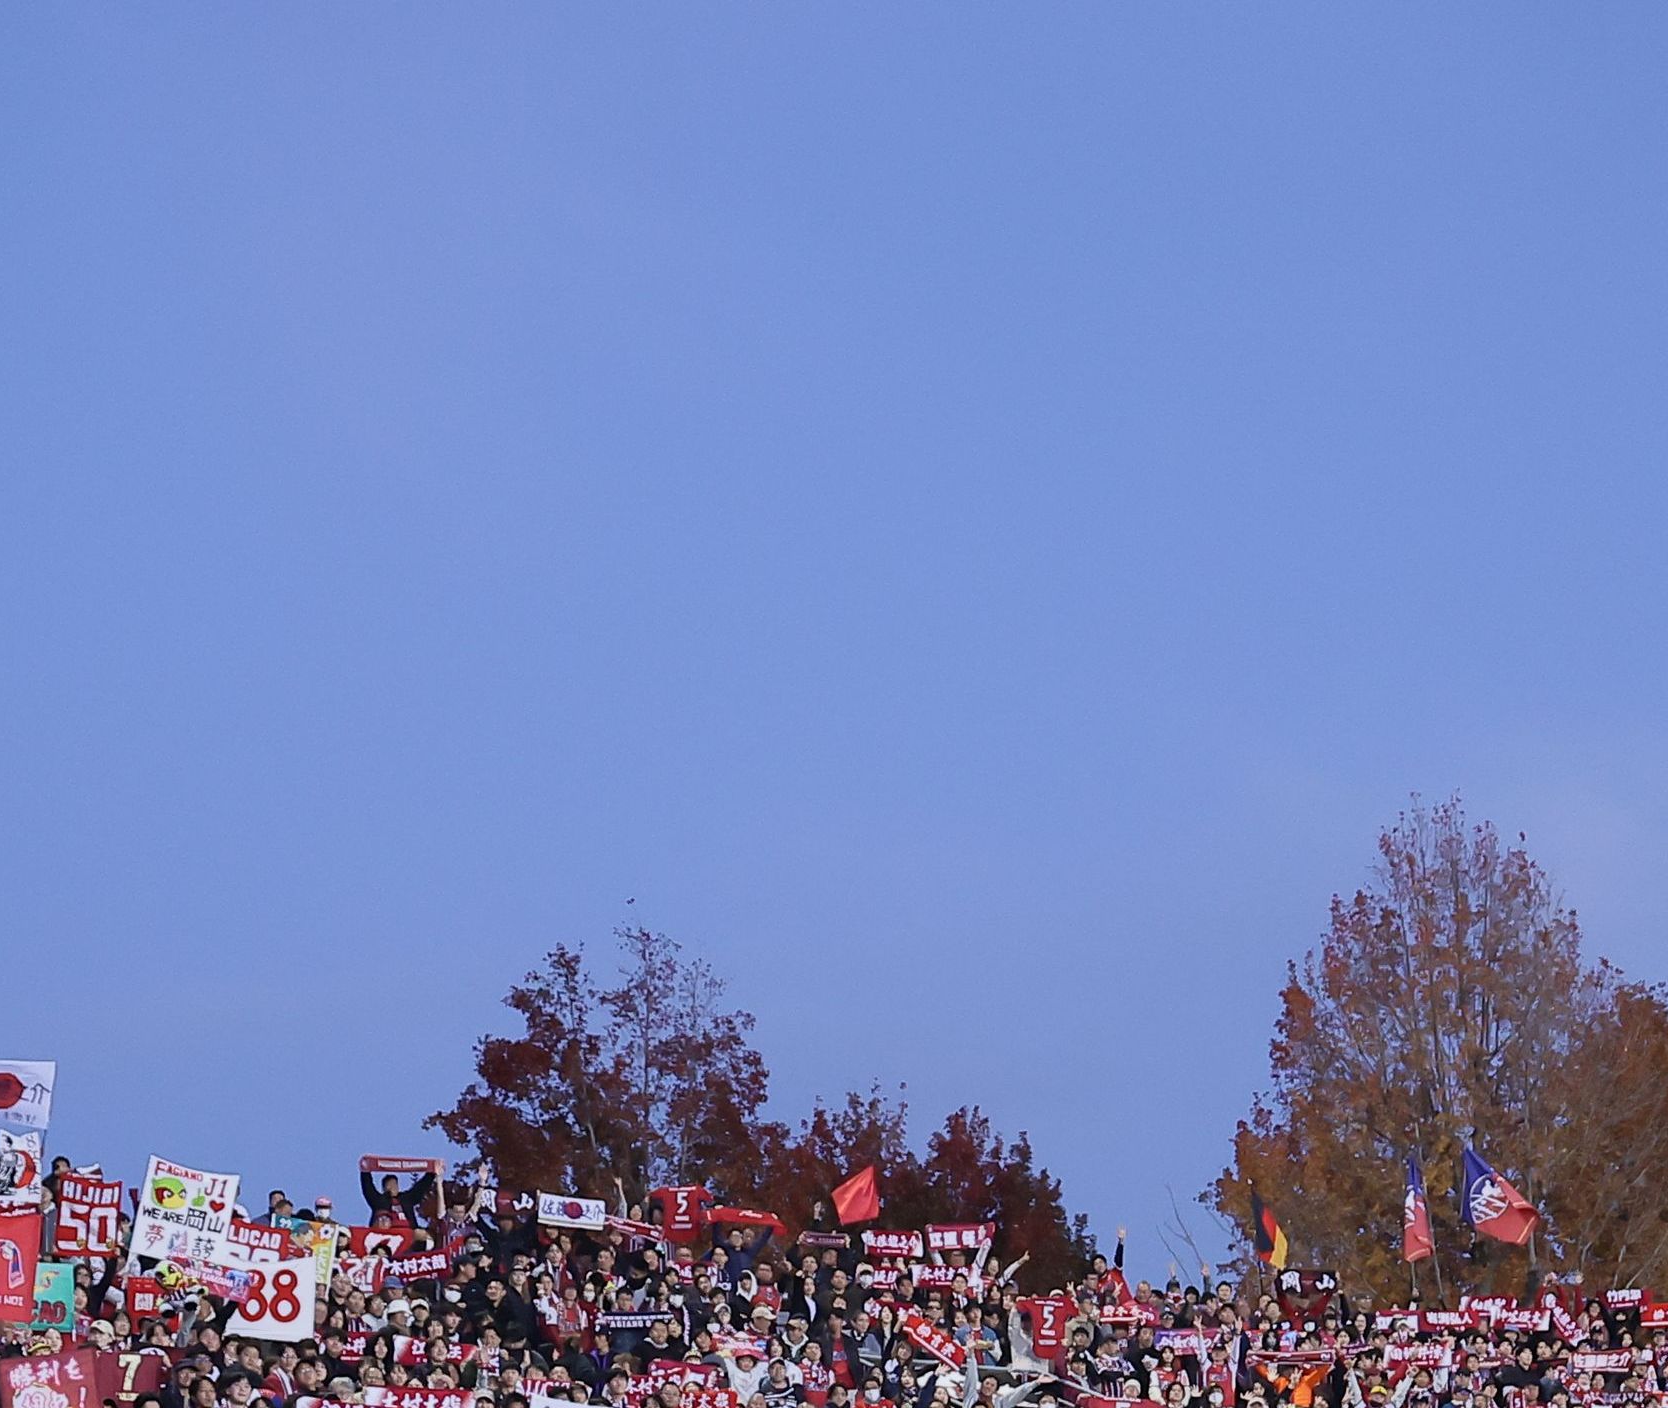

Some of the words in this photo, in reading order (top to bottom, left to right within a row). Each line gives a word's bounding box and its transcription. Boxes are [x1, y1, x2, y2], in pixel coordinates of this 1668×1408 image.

[154, 1160, 204, 1183] FAGIANO
[205, 1178, 228, 1199] J1
[142, 1207, 160, 1220] WE
[161, 1210, 186, 1224] ARE
[675, 1190, 688, 1213] 5
[57, 1202, 119, 1251] 50
[240, 1268, 302, 1323] 88
[1042, 1306, 1055, 1330] 5
[9, 1358, 85, 1390] 勝利を
[121, 1354, 142, 1392] 7
